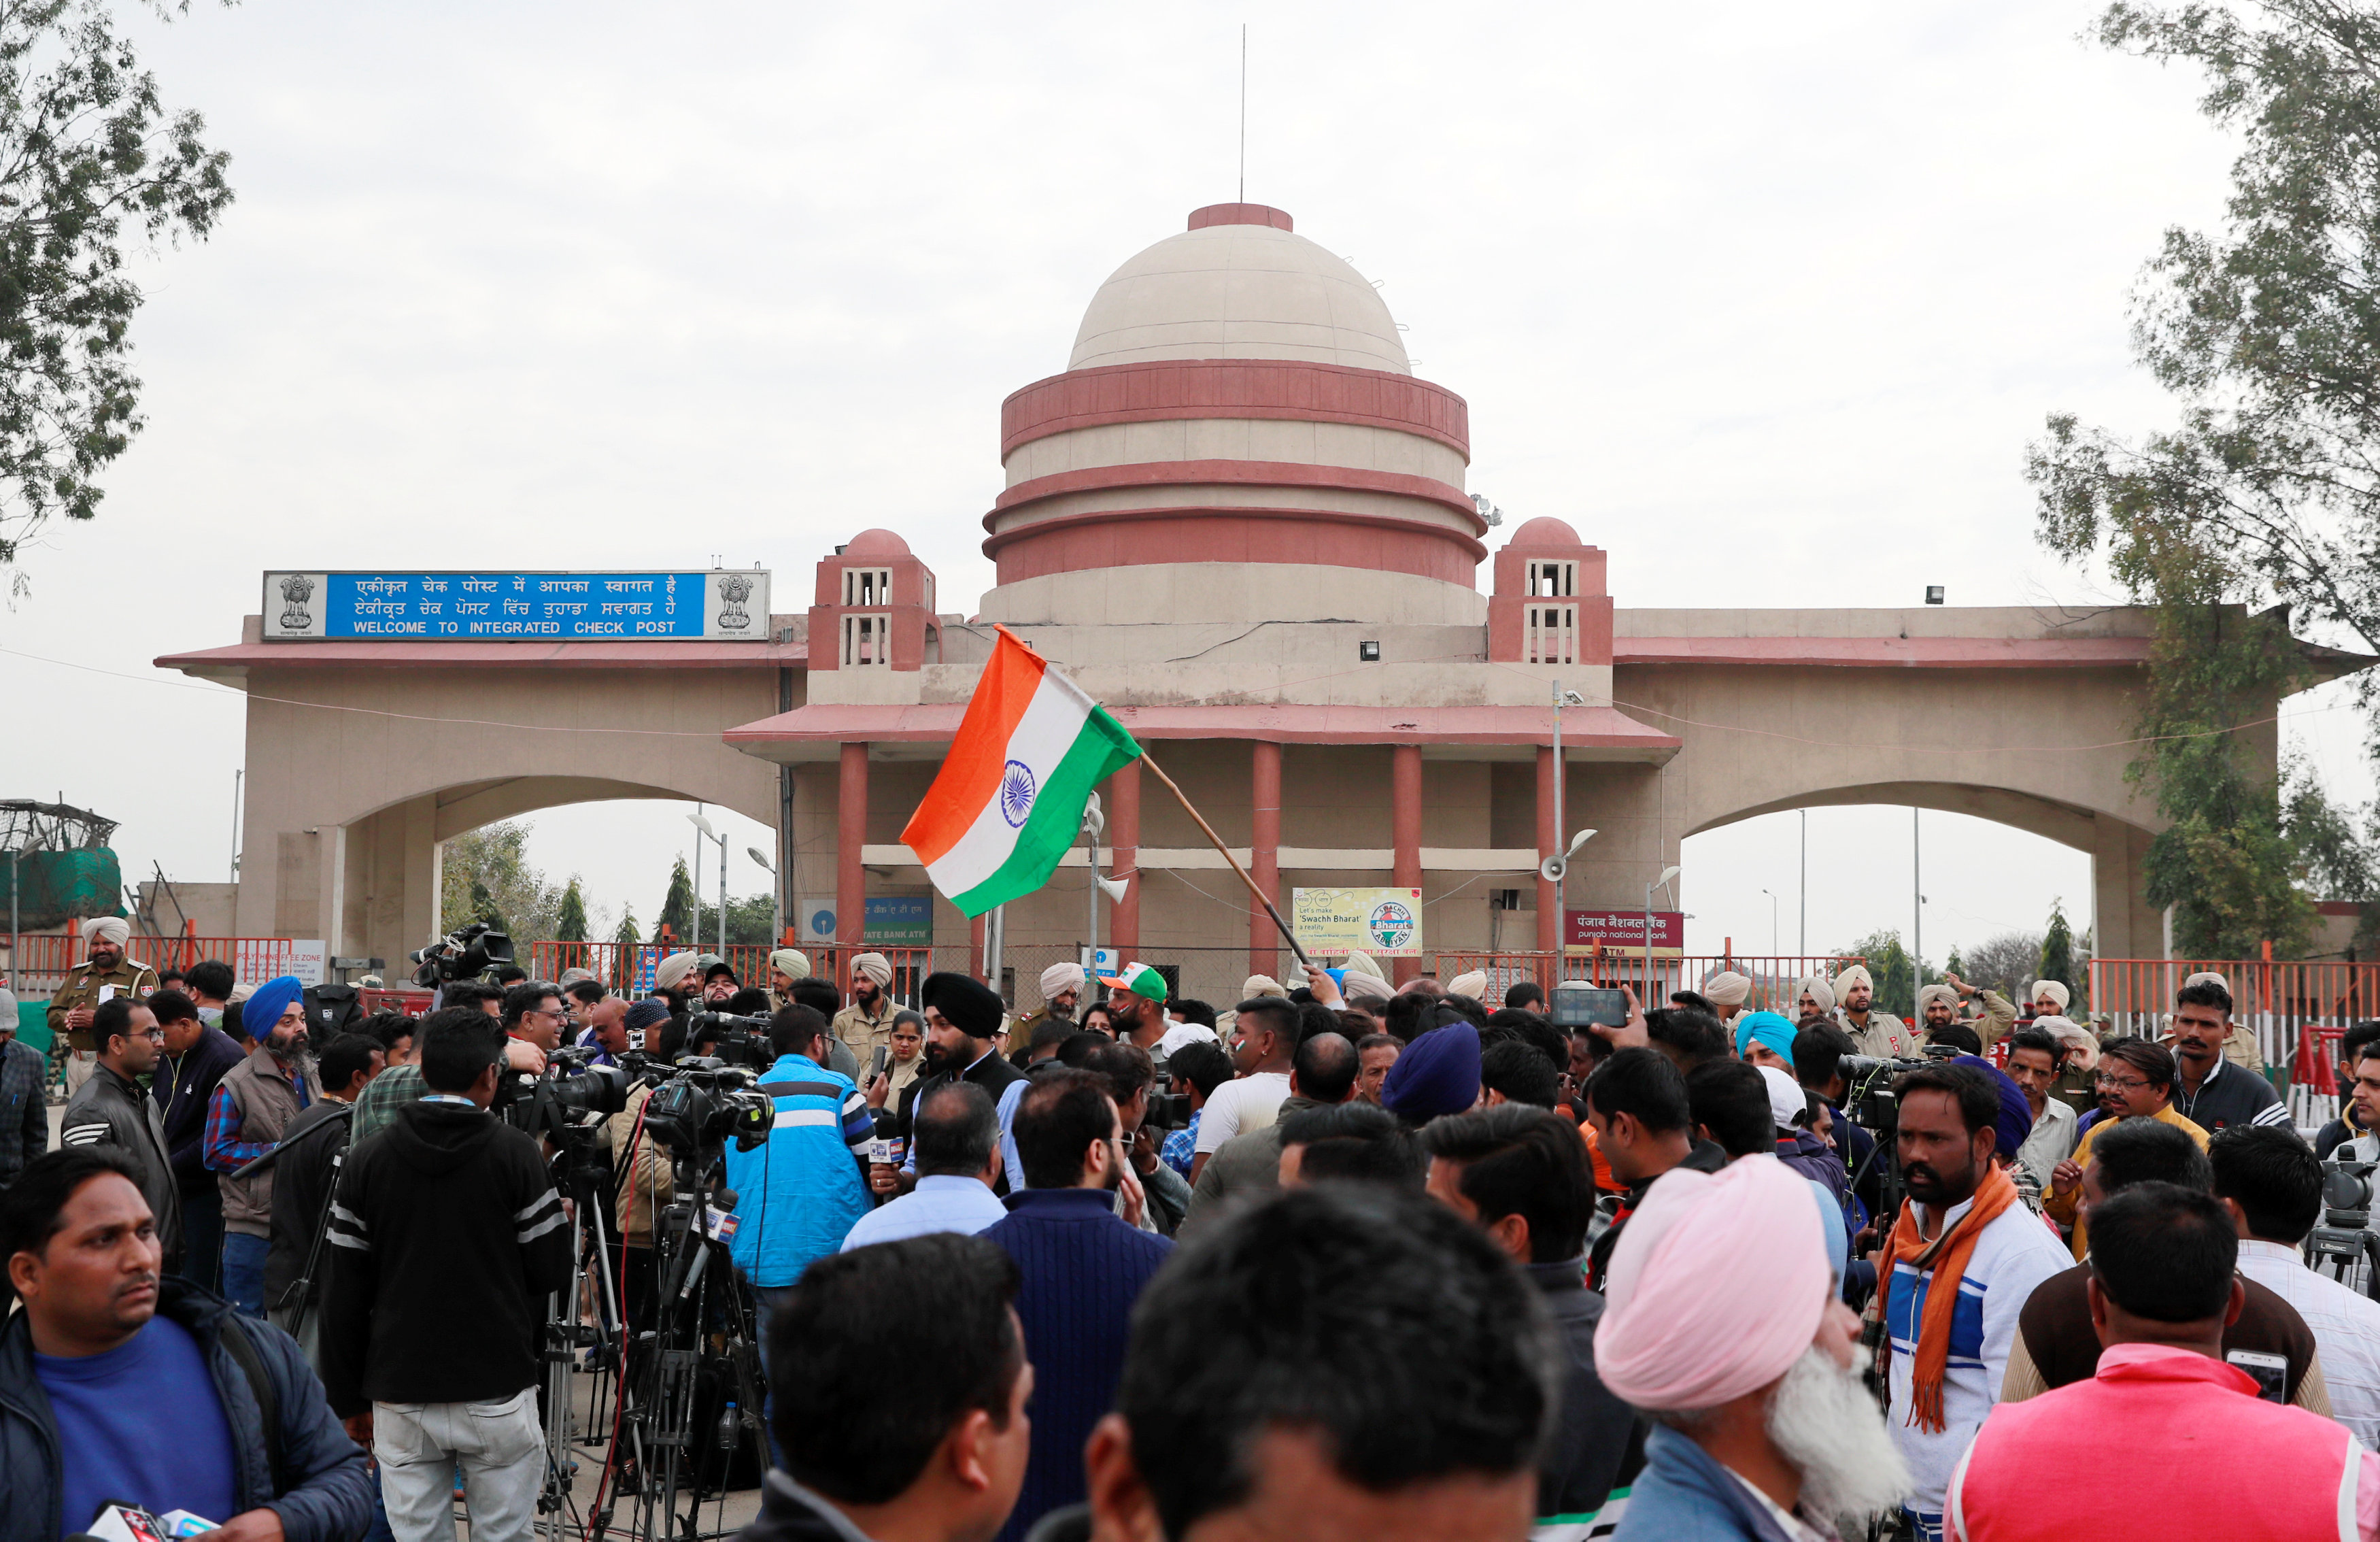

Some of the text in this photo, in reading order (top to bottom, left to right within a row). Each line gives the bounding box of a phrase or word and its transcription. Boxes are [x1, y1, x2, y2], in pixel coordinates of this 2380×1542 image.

[355, 575, 676, 597] एकीकृत चेक पोस्ट में आपका स्वागत है
[419, 597, 443, 615] ਚੇਕ
[456, 598, 490, 615] ਪੋਸਟ
[503, 598, 530, 615] ਵਿੱਚ
[543, 603, 588, 618] ਤੁਹਾਡਾ
[601, 603, 653, 615] ਸਵਾਗਤ
[666, 595, 676, 615] ਹੈ
[354, 622, 676, 633] WELCOME TO INTEGRATED CHECK POST
[1379, 905, 1406, 916] SWACHH
[1376, 920, 1408, 929] Bharat
[1577, 915, 1605, 927] पंजाब
[1608, 914, 1644, 928] नैशनल
[1375, 931, 1408, 945] ABHIYAN
[1578, 930, 1667, 939] punjab national ank
[1377, 948, 1399, 957] सुरक्षा
[2320, 1243, 2347, 1252] Libec
